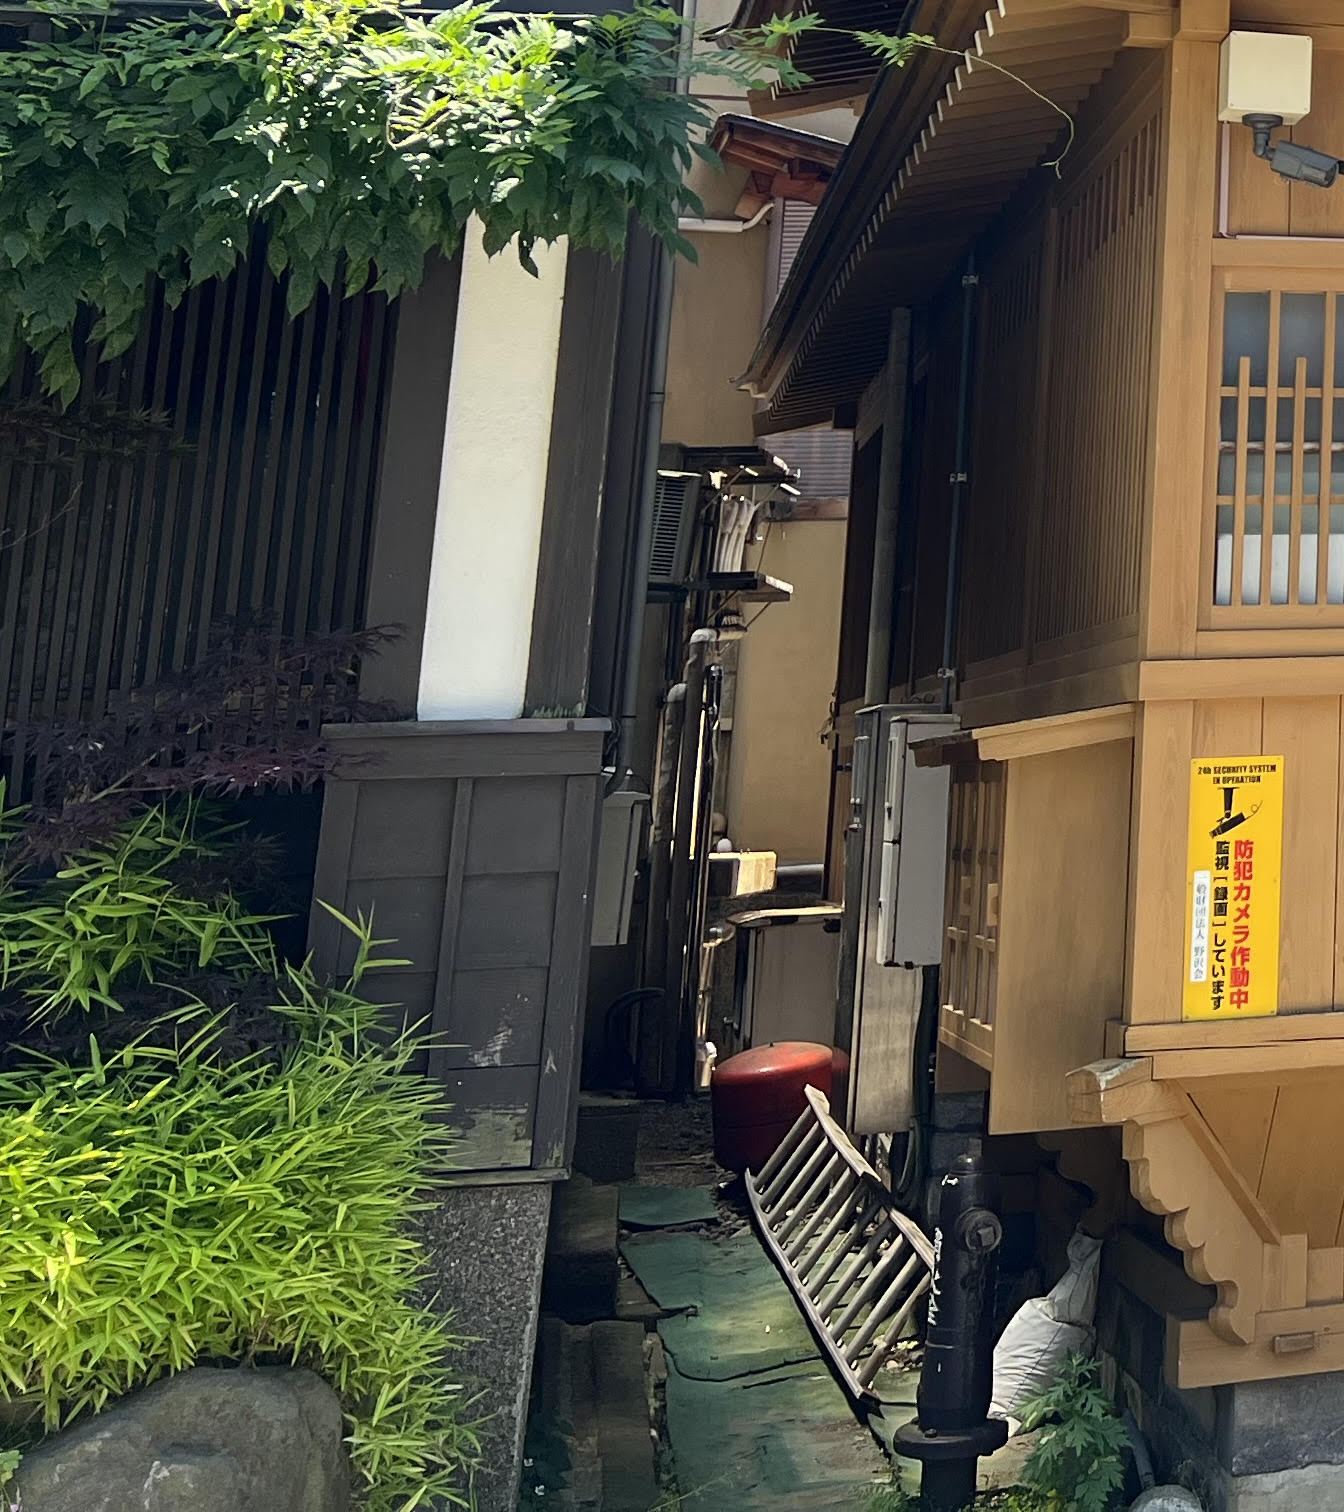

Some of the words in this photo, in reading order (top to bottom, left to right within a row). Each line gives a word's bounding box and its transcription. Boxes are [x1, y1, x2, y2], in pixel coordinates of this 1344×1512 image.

[1213, 765, 1247, 774] SECURITY
[1249, 764, 1277, 773] SYSTEM
[1213, 776, 1221, 784] IN
[1222, 775, 1261, 784] OPERATION
[1229, 839, 1254, 1010] 防犯カメラ作動中
